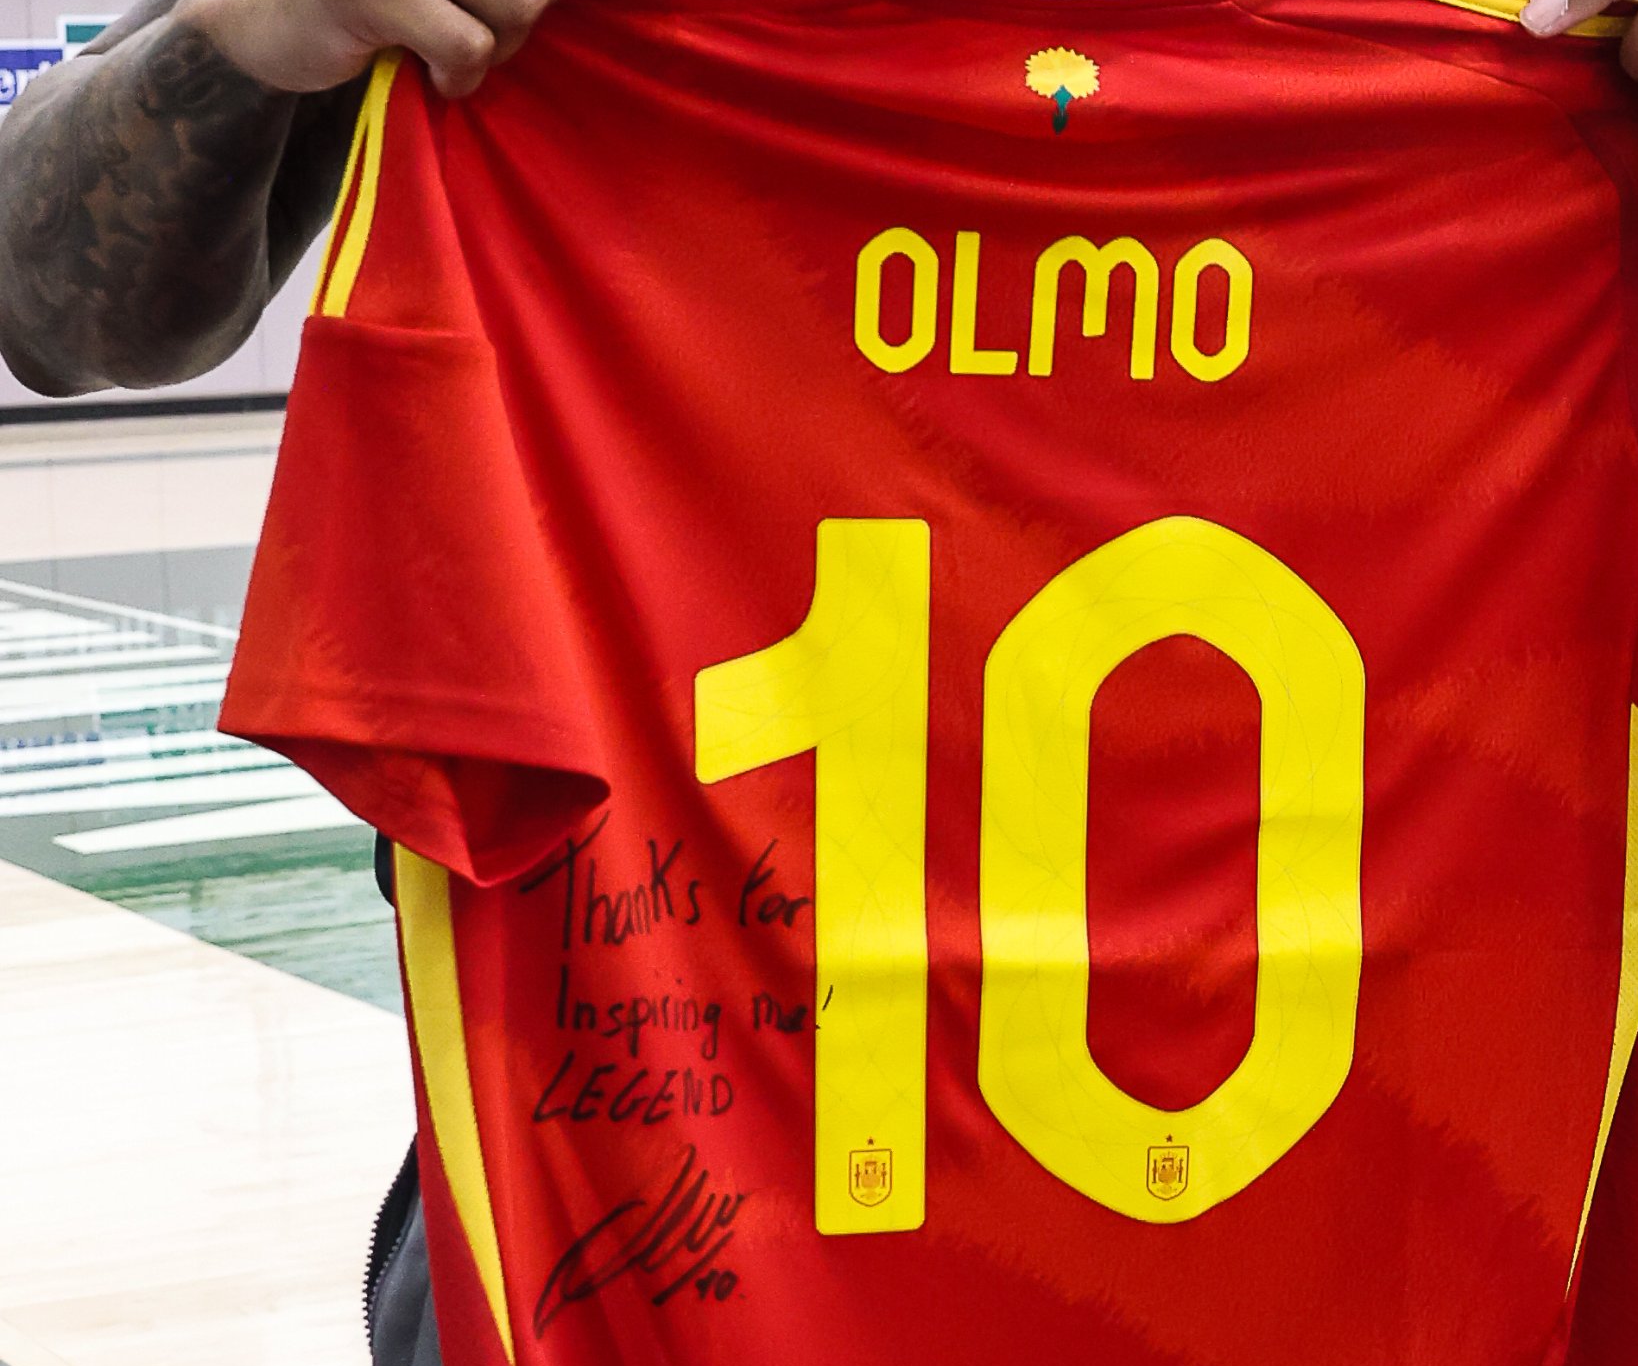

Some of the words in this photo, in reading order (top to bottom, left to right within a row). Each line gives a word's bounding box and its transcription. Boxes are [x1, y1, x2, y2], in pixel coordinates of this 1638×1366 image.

[854, 226, 1254, 383] OLMO
[694, 515, 1366, 1236] 10
[533, 1050, 734, 1125] LEGEND
